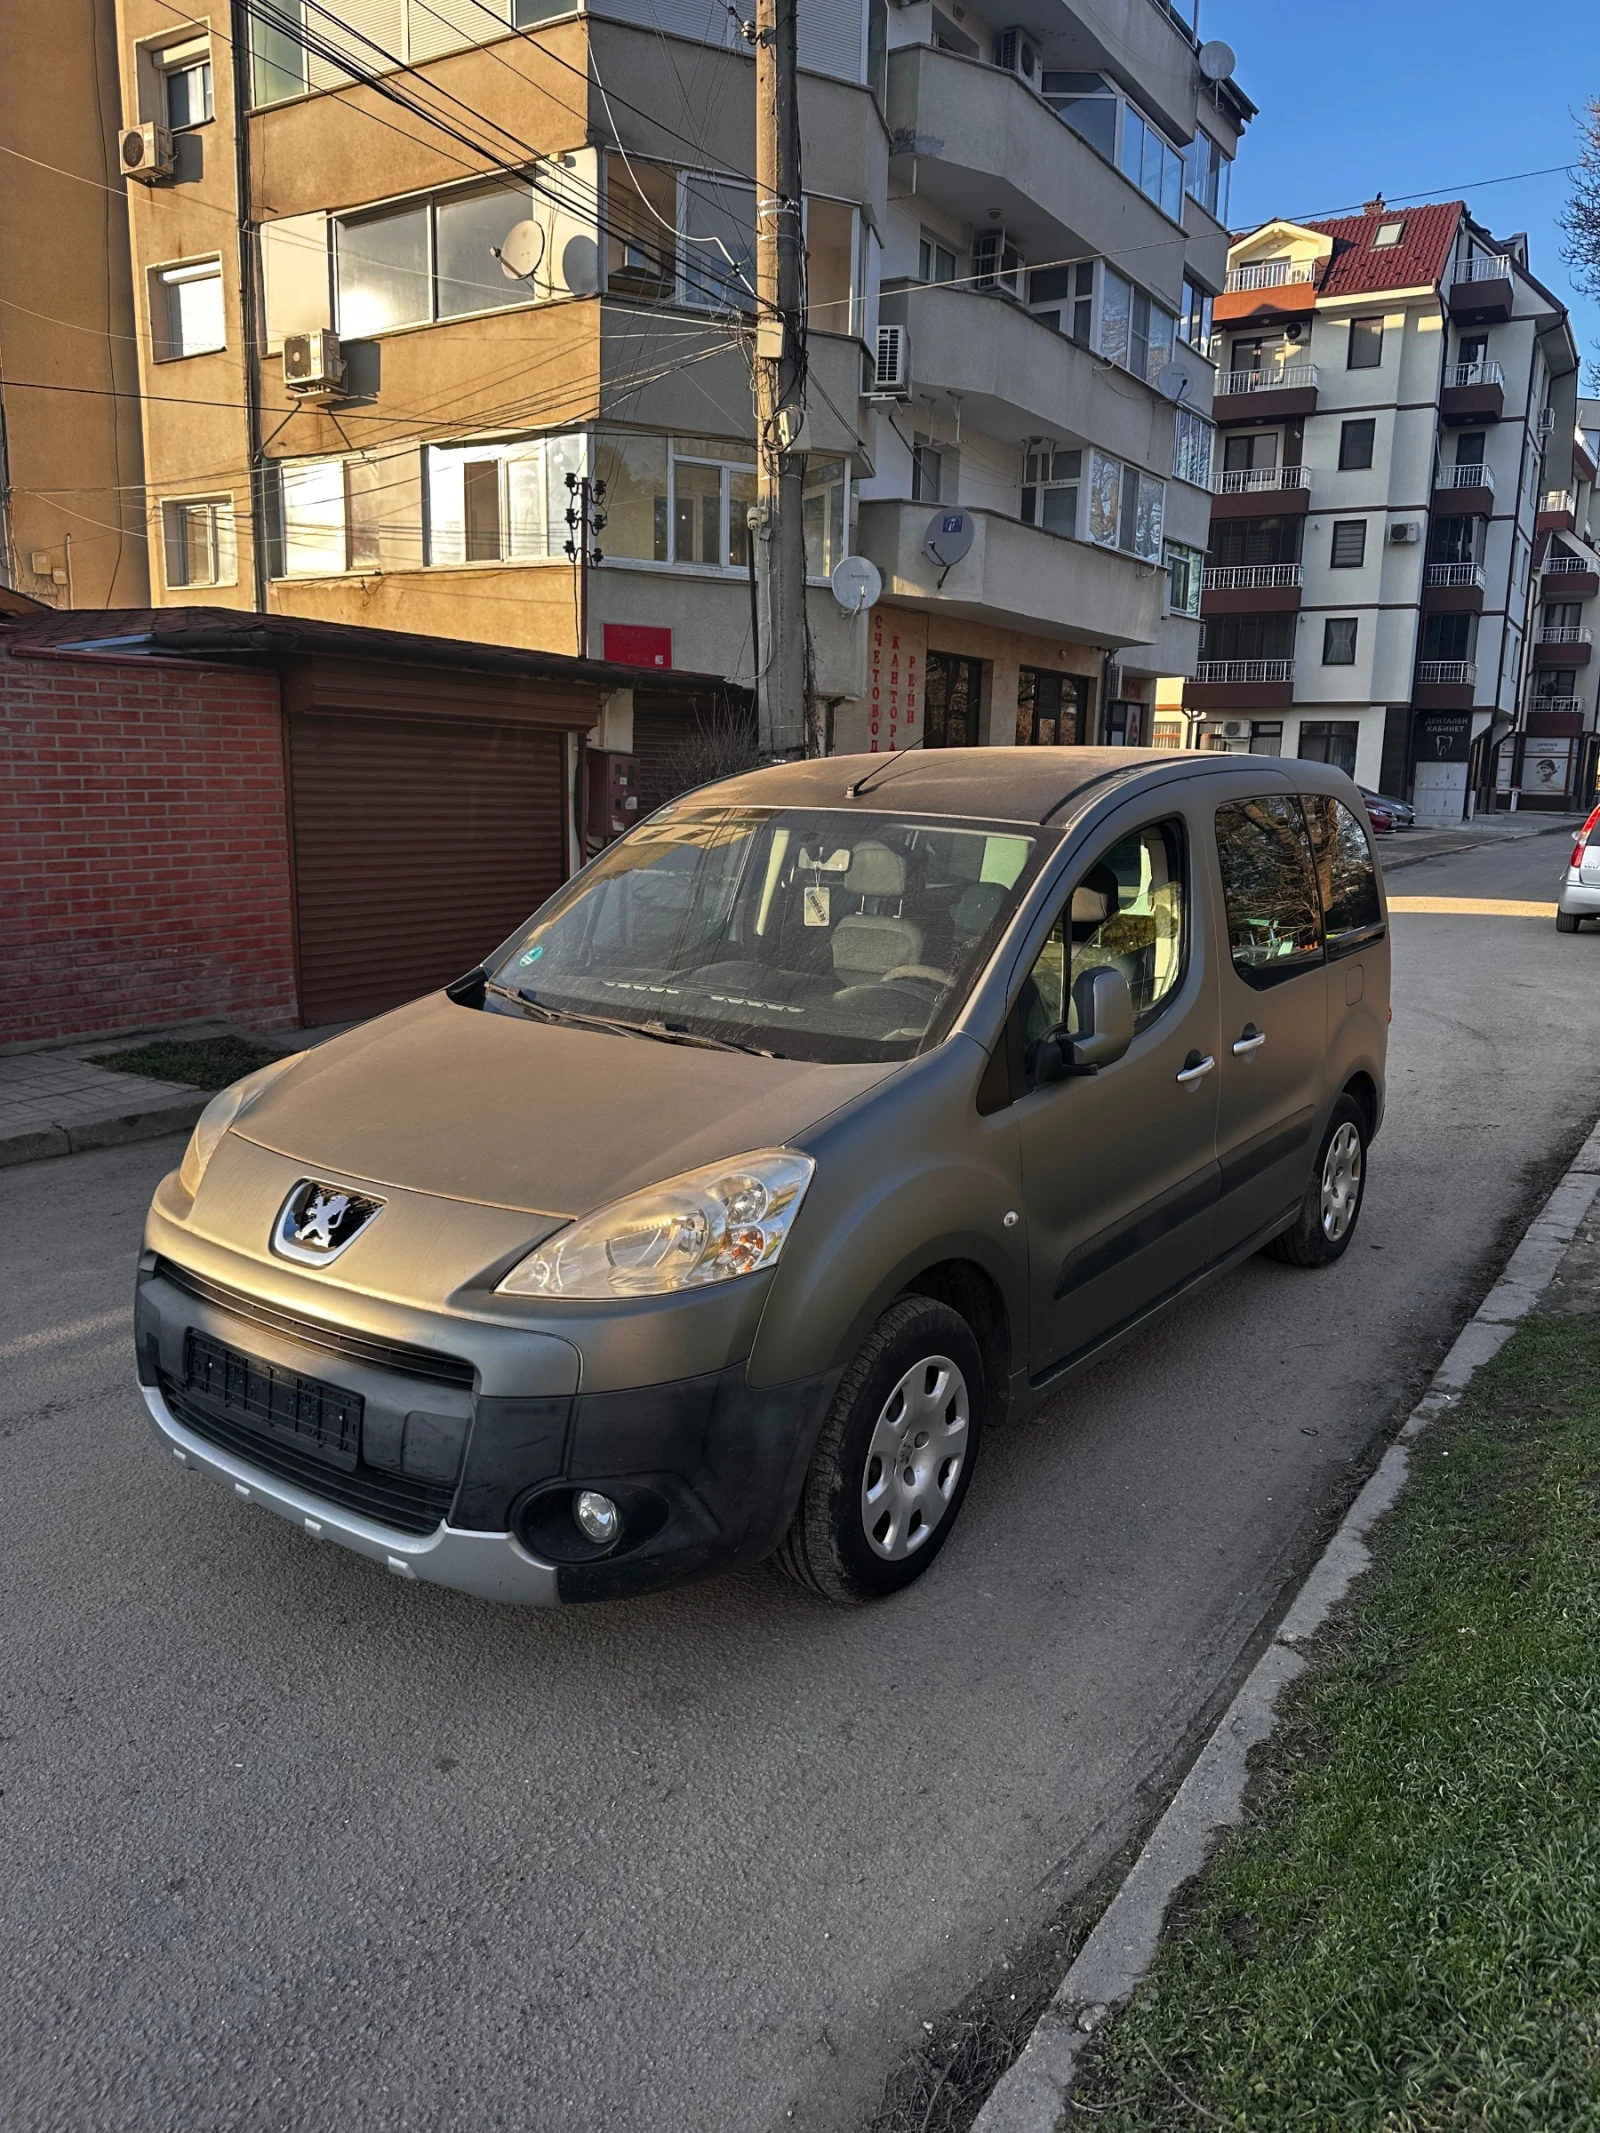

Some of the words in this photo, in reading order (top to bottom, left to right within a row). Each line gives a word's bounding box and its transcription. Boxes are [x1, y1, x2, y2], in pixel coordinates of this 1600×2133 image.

[889, 636, 900, 752] КАНТОРА
[907, 656, 916, 724] РЕЙН
[1425, 717, 1468, 725] ДЕНТАЛЕН
[810, 895, 827, 922] mobile.bg
